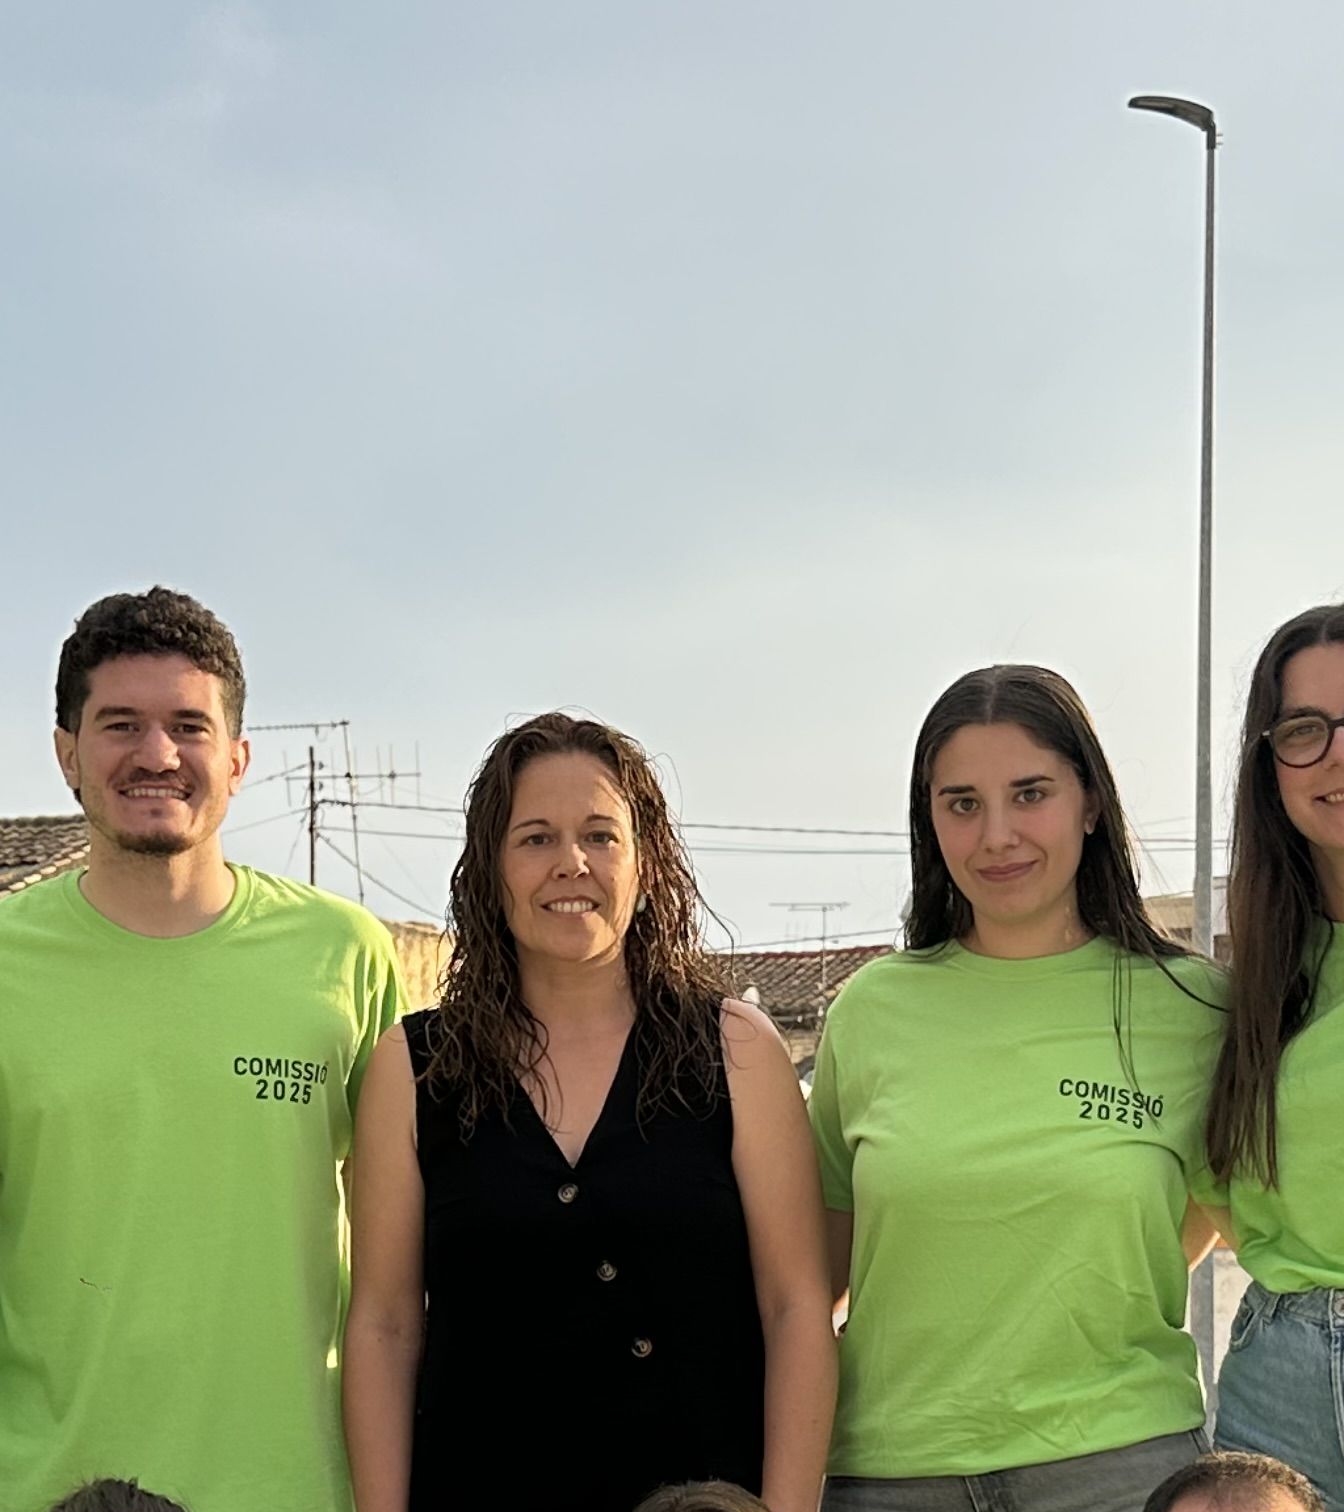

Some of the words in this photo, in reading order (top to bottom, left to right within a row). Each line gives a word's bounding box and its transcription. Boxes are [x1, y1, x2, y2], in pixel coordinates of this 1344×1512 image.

[234, 1057, 329, 1085] COMISSIÓ
[255, 1079, 312, 1105] 2025
[1059, 1078, 1164, 1118] COMISSIÓ
[1079, 1100, 1144, 1129] 2025
